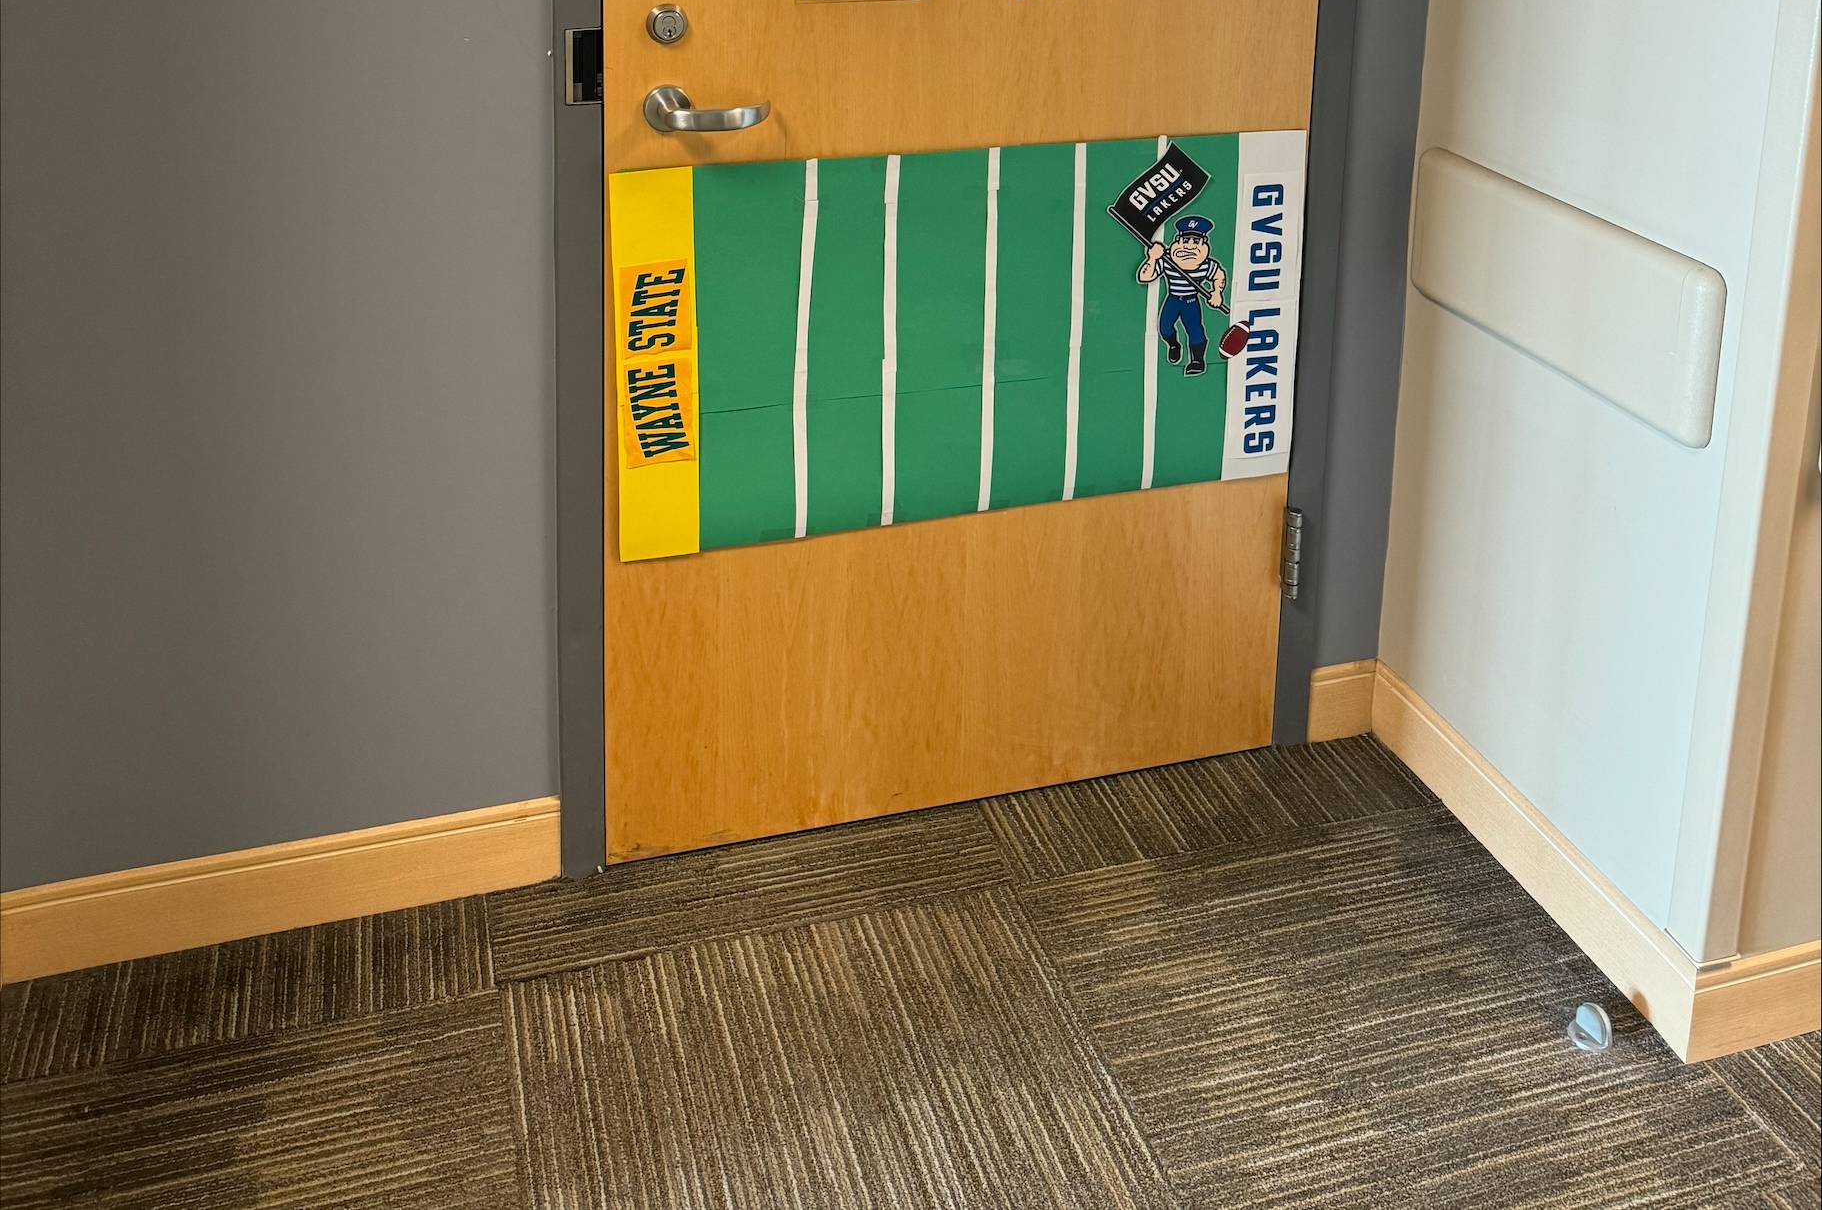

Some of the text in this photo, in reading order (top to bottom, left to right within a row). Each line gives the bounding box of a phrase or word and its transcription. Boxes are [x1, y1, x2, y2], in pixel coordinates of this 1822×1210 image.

[1129, 163, 1180, 210] GVSU
[1147, 181, 1192, 222] LAKERS
[627, 268, 690, 459] WAYNE STATE
[1243, 184, 1284, 454] GVSU LAKERS
